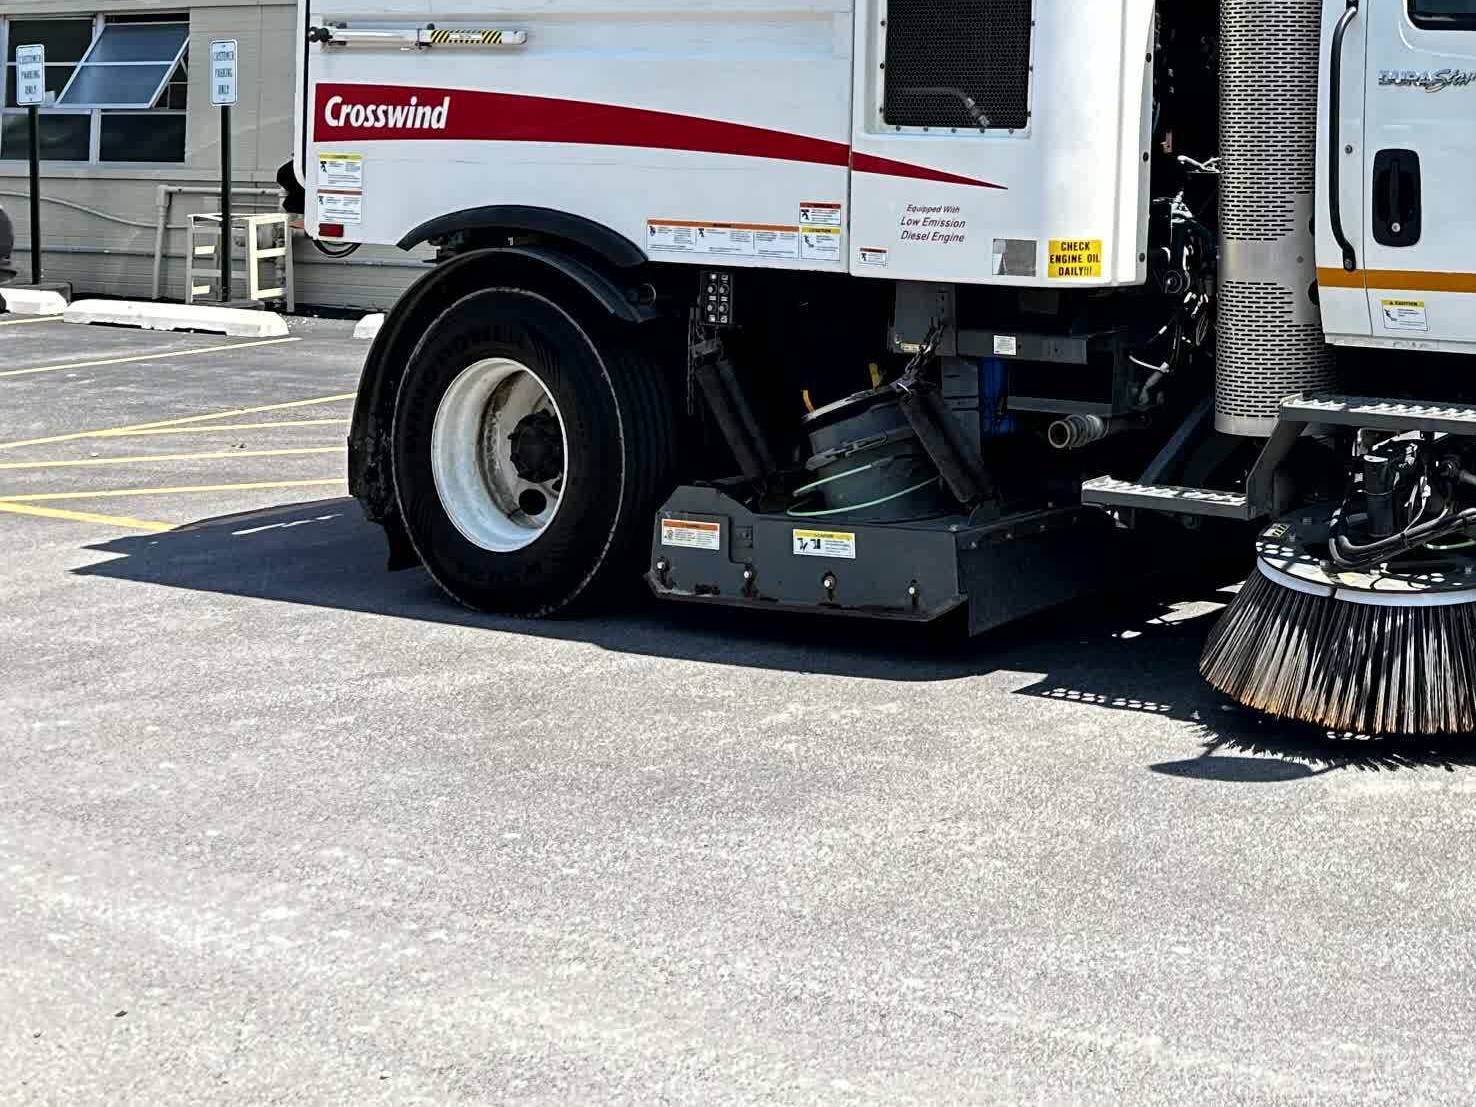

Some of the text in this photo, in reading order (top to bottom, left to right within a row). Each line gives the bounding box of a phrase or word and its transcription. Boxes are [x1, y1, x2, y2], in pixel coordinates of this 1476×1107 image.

[325, 96, 450, 129] Crosswind
[906, 204, 960, 214] Equipped With
[900, 216, 966, 228] Low Emission
[900, 230, 965, 244] Diesel Engine
[1060, 241, 1091, 251] CHECK
[1049, 253, 1101, 264] ENGINE OIL
